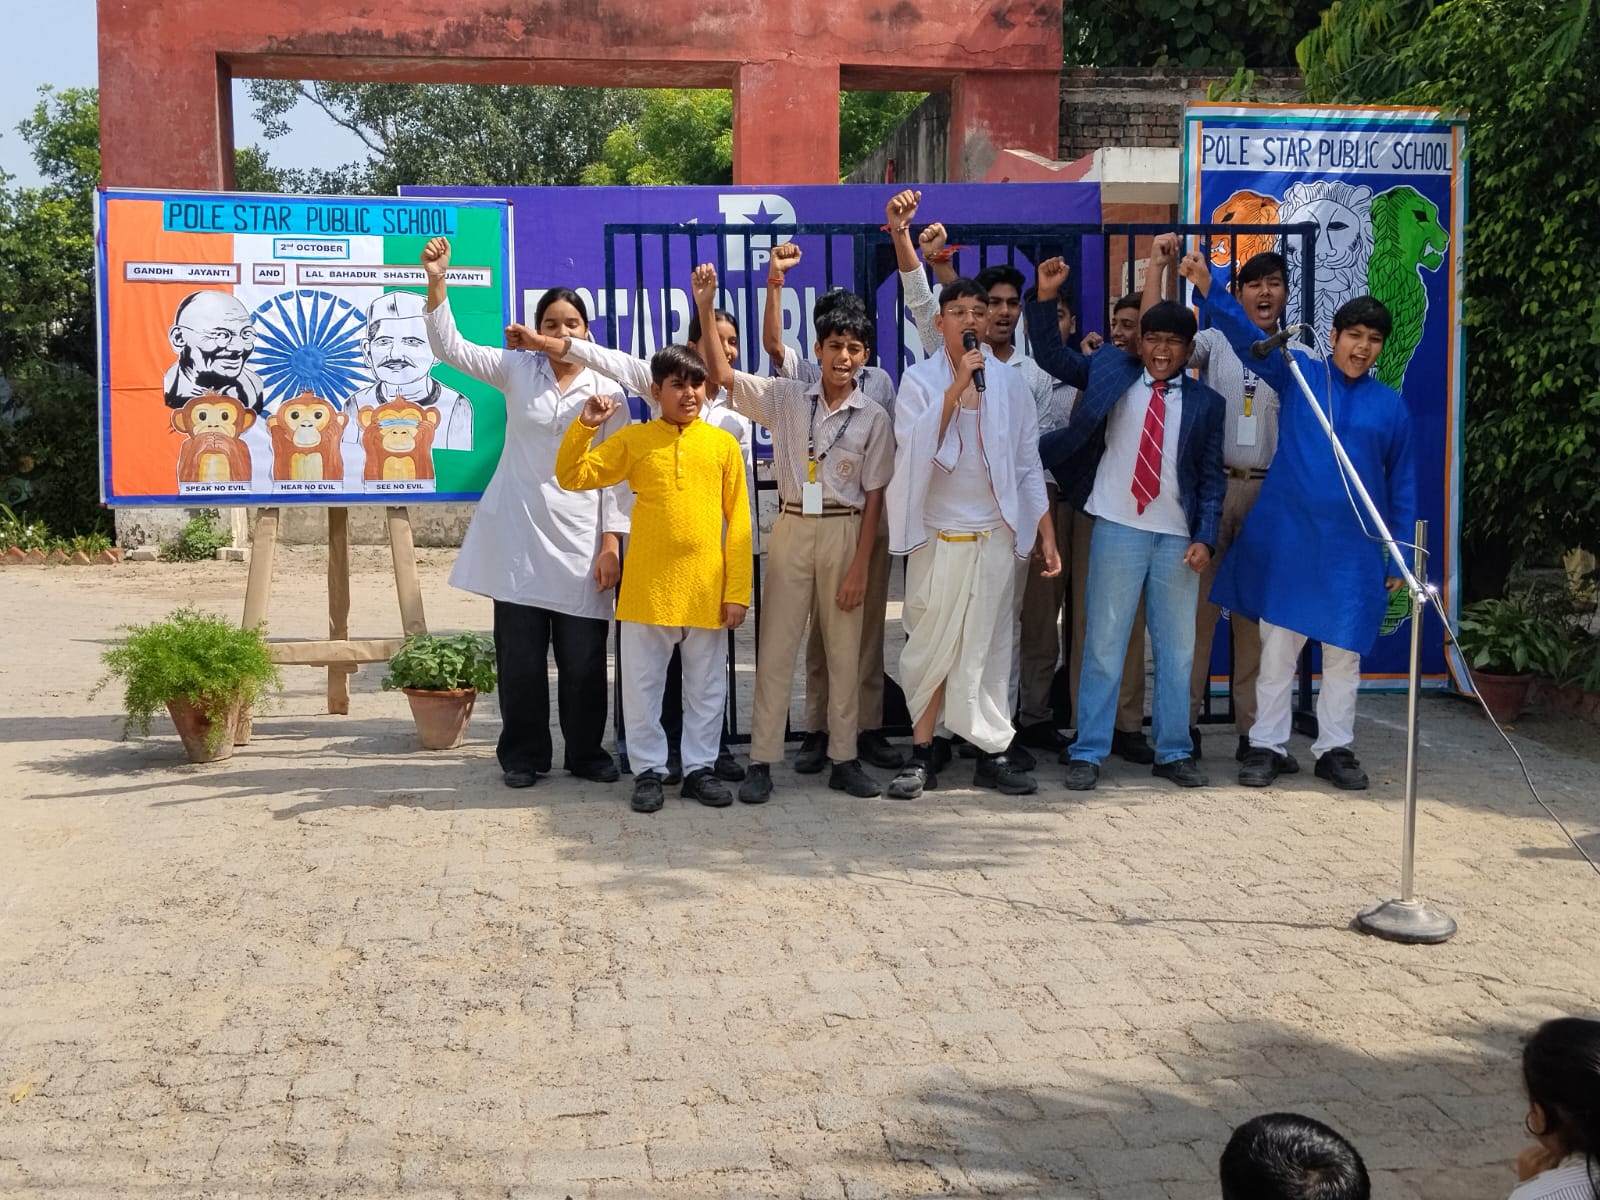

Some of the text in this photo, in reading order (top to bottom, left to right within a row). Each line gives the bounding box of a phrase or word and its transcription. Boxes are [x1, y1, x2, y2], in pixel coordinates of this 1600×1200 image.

[1202, 134, 1453, 171] POLE STAR PUBLIC SCHOOL
[168, 203, 455, 236] POLE STAR PUBLIC SCHOOL
[280, 243, 343, 253] 2nd OCTOBER
[133, 266, 230, 277] GANDHI JAYANTI
[258, 269, 281, 278] AND
[305, 270, 484, 282] LAL BAHADUR SHASTRI JAYANTI
[185, 485, 213, 493] SPEAK
